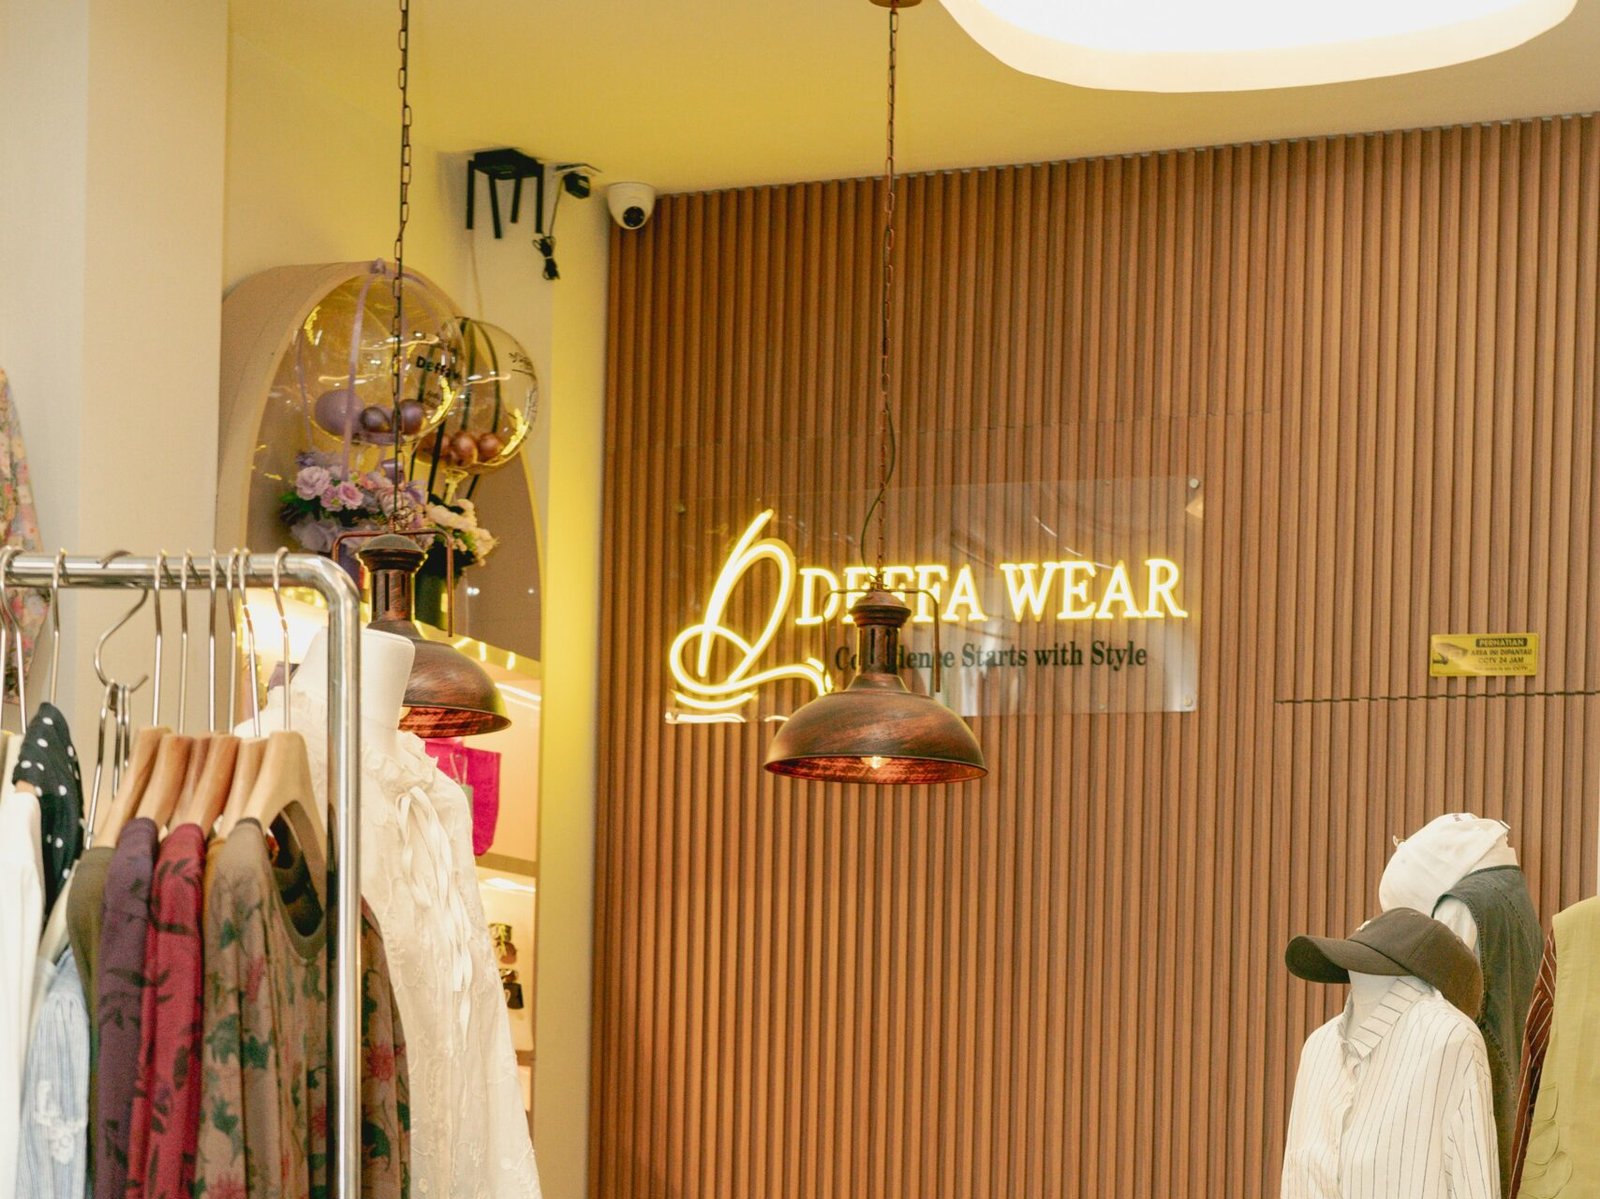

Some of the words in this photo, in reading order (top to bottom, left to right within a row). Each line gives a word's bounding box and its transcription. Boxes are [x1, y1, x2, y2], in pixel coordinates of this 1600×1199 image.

[999, 558, 1189, 623] WEAR
[961, 642, 1028, 667] Starts
[1034, 641, 1083, 666] with
[1091, 641, 1148, 671] Style
